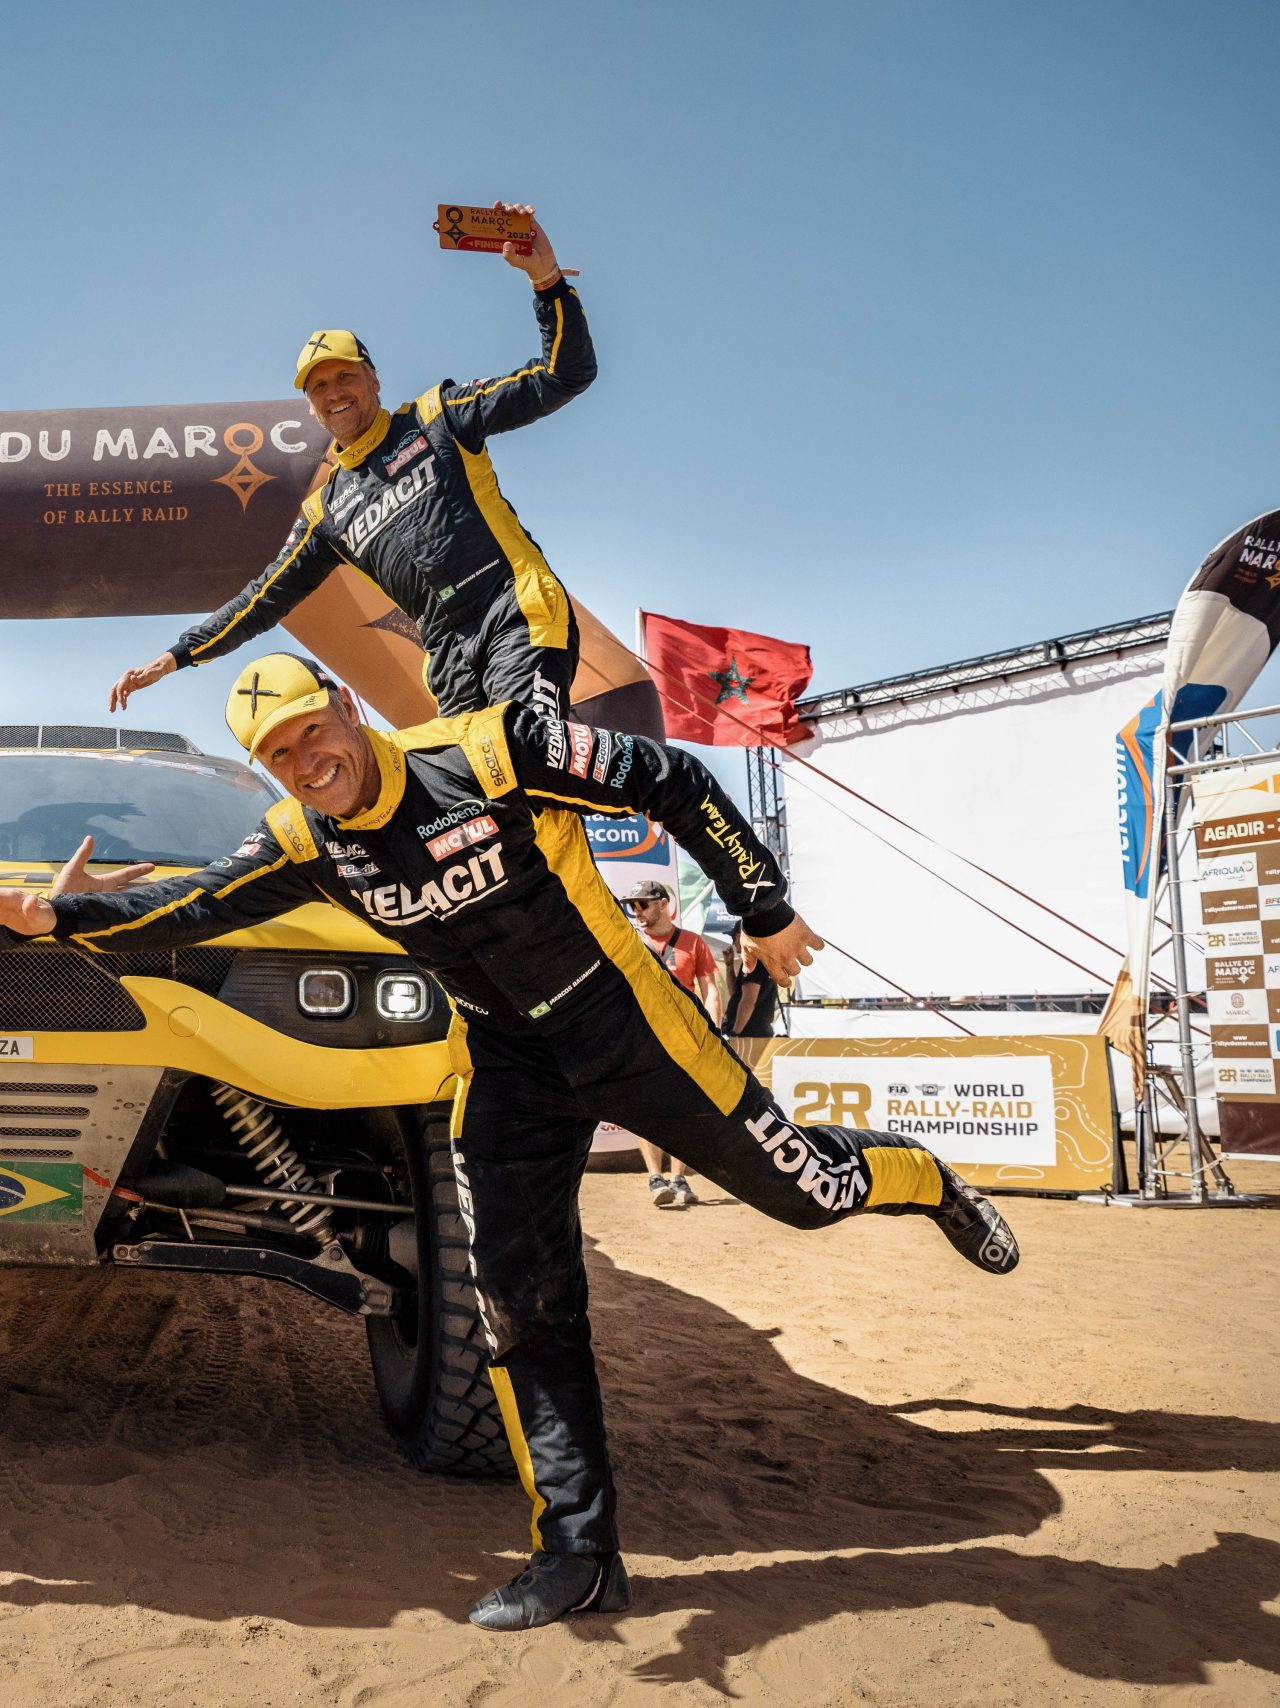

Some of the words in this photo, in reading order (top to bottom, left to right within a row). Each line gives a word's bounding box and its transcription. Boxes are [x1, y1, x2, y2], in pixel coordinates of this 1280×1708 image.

[470, 208, 499, 216] RALLYE
[471, 215, 513, 226] MAROC
[474, 240, 521, 251] FINISR
[0, 429, 71, 463] DU
[93, 420, 308, 463] MAROC
[44, 482, 83, 498] THE
[88, 479, 174, 497] ESSENCE
[327, 477, 360, 513] VEDACI
[340, 454, 436, 553] VEDACIT
[43, 509, 69, 525] OF
[74, 507, 135, 524] RALLY
[139, 505, 189, 522] RAID
[1244, 535, 1280, 553] RALL
[1239, 548, 1280, 570] MAR
[547, 719, 563, 769] VEDAC
[480, 736, 508, 788] sparco
[417, 804, 480, 839] Rodobens
[1204, 820, 1265, 842] AGADIR
[282, 818, 305, 854] arco
[433, 819, 494, 857] MOTUL
[586, 828, 639, 843] ecom
[325, 841, 368, 858] VEAC
[1208, 934, 1226, 948] 2R
[1214, 960, 1242, 968] RALLYE
[1244, 959, 1255, 967] DU
[1215, 966, 1256, 977] MAROC
[549, 985, 573, 1006] MARCOS
[572, 959, 601, 988] BAUMGART
[888, 1085, 908, 1094] FIA
[954, 1084, 1024, 1097] WORLD
[793, 1082, 872, 1129] 2R
[887, 1100, 1033, 1118] RALLY-RAID
[887, 1120, 1038, 1136] CHAMPIONSHIP
[985, 1221, 1013, 1262] OM
